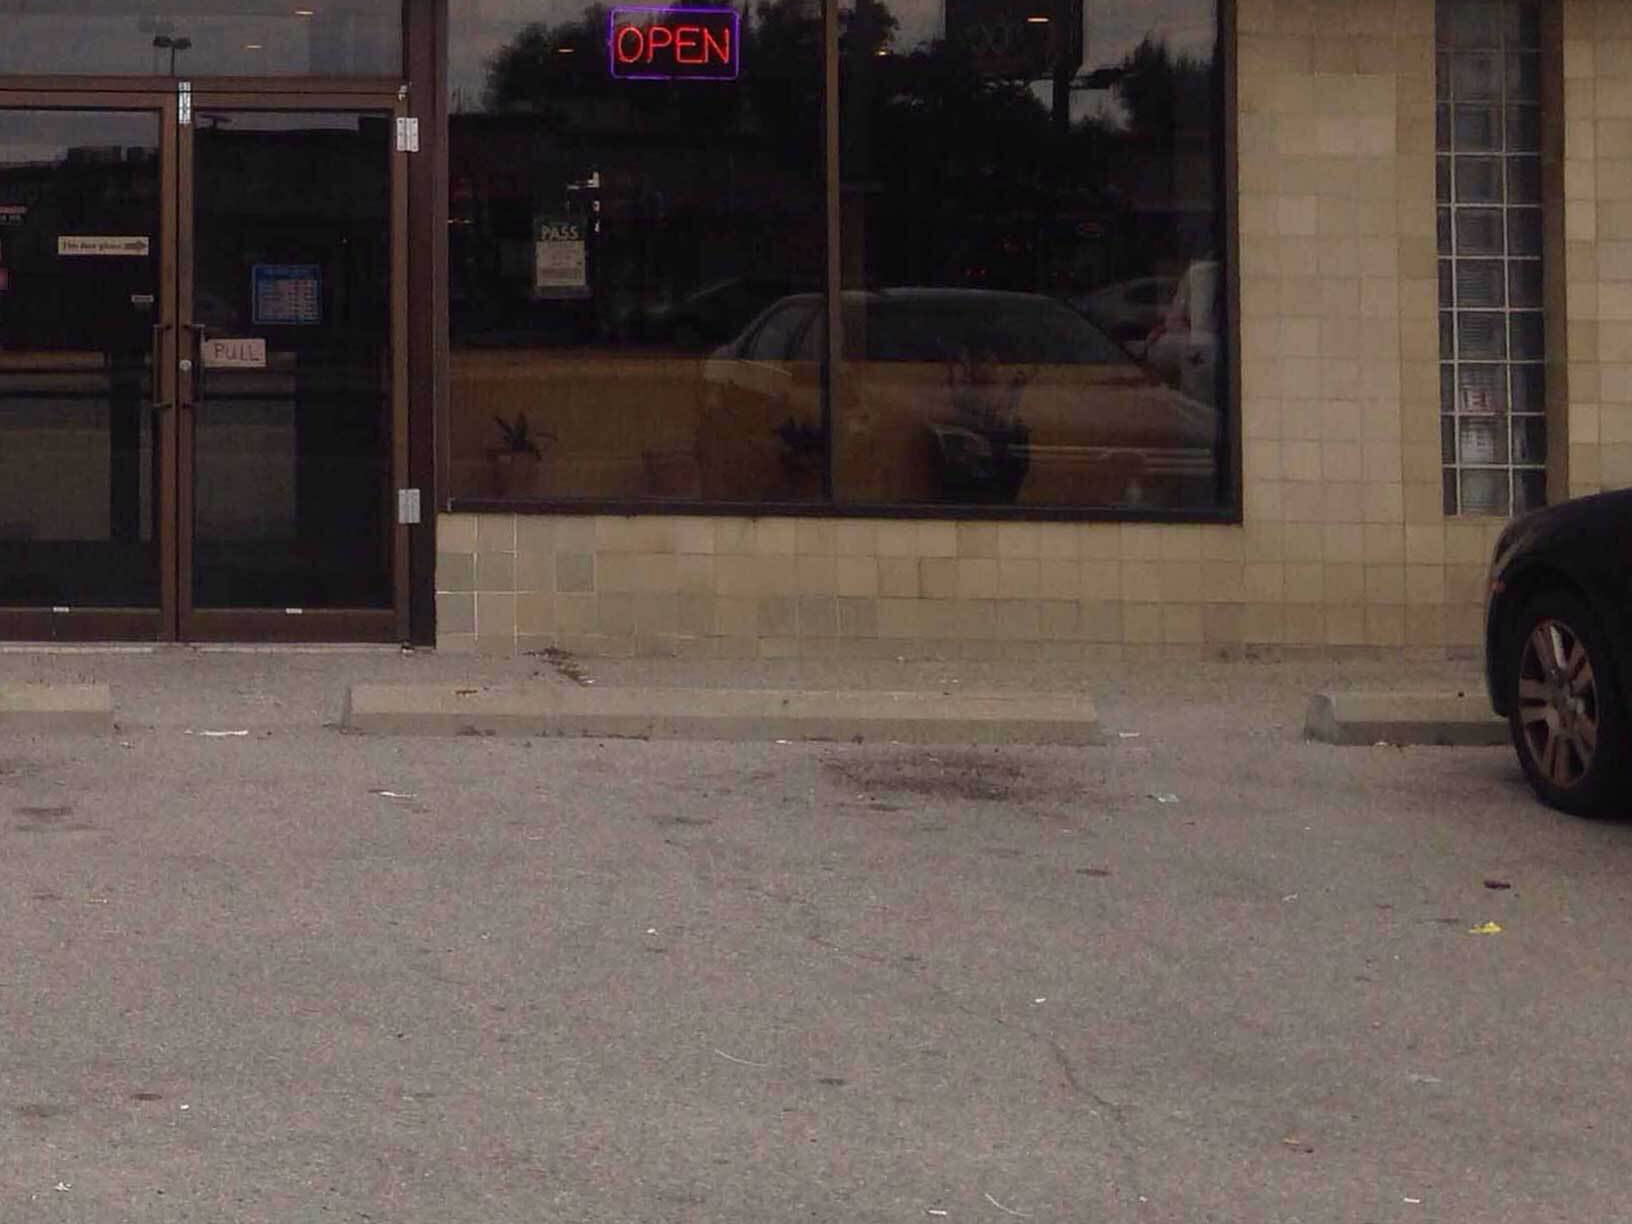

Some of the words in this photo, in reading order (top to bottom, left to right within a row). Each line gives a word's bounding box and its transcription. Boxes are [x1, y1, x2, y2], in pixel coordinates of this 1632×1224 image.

[617, 23, 731, 66] OPEN
[541, 224, 579, 241] PASS
[213, 342, 261, 362] PULL
